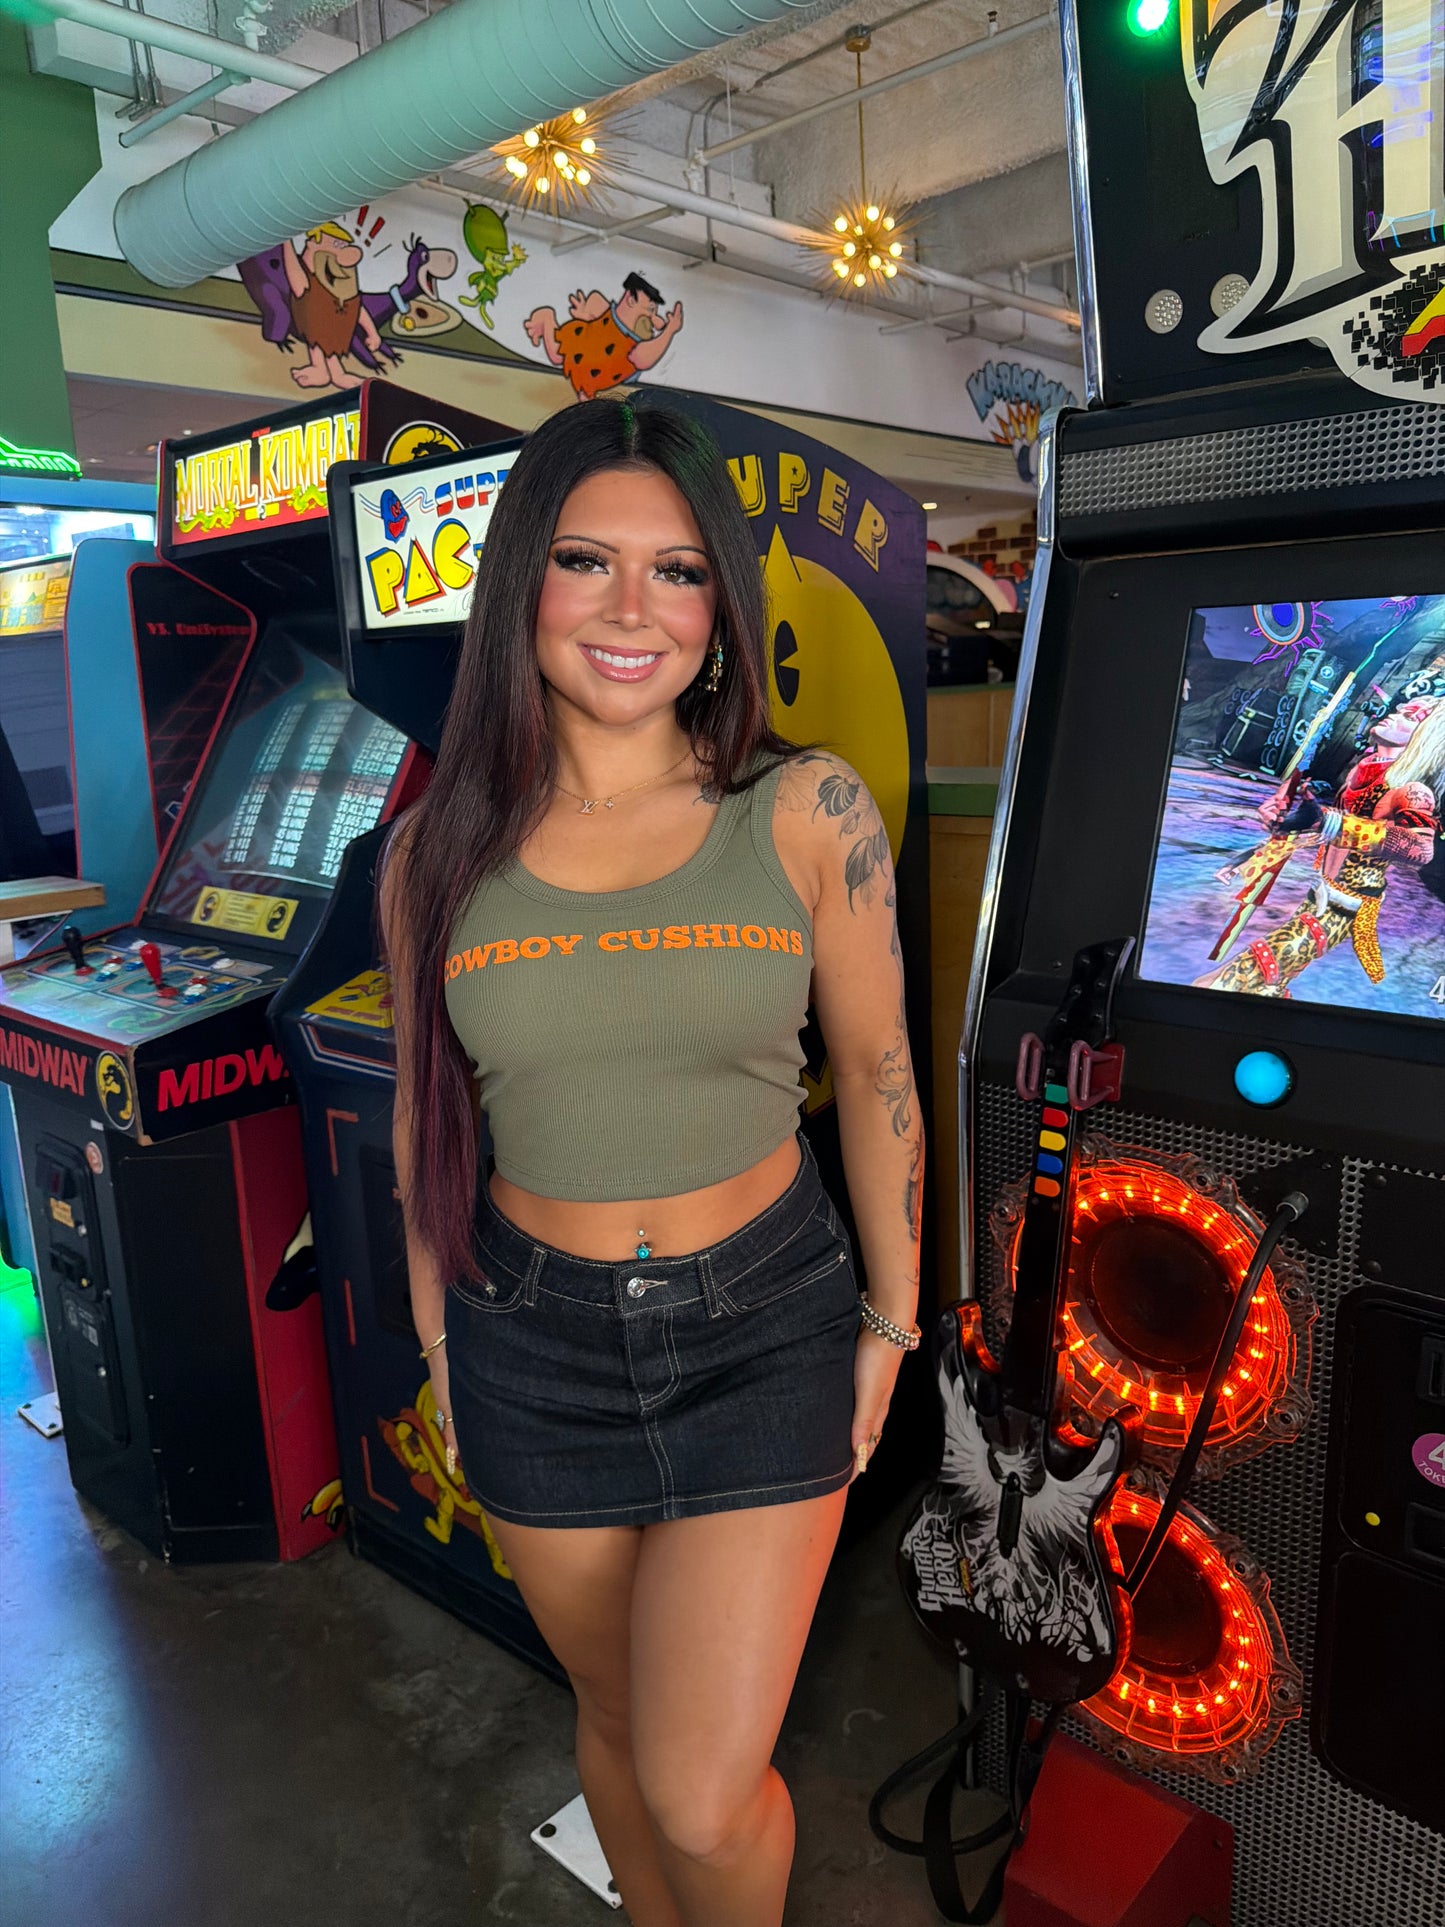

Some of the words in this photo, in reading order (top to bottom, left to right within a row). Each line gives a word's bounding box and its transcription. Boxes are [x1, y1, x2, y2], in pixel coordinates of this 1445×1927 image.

[175, 440, 258, 522] MORTAL
[258, 410, 360, 503] KOMBAT
[598, 924, 804, 957] CUSHIONS
[0, 1028, 89, 1096] MIDWAY
[157, 1044, 289, 1112] MIDW
